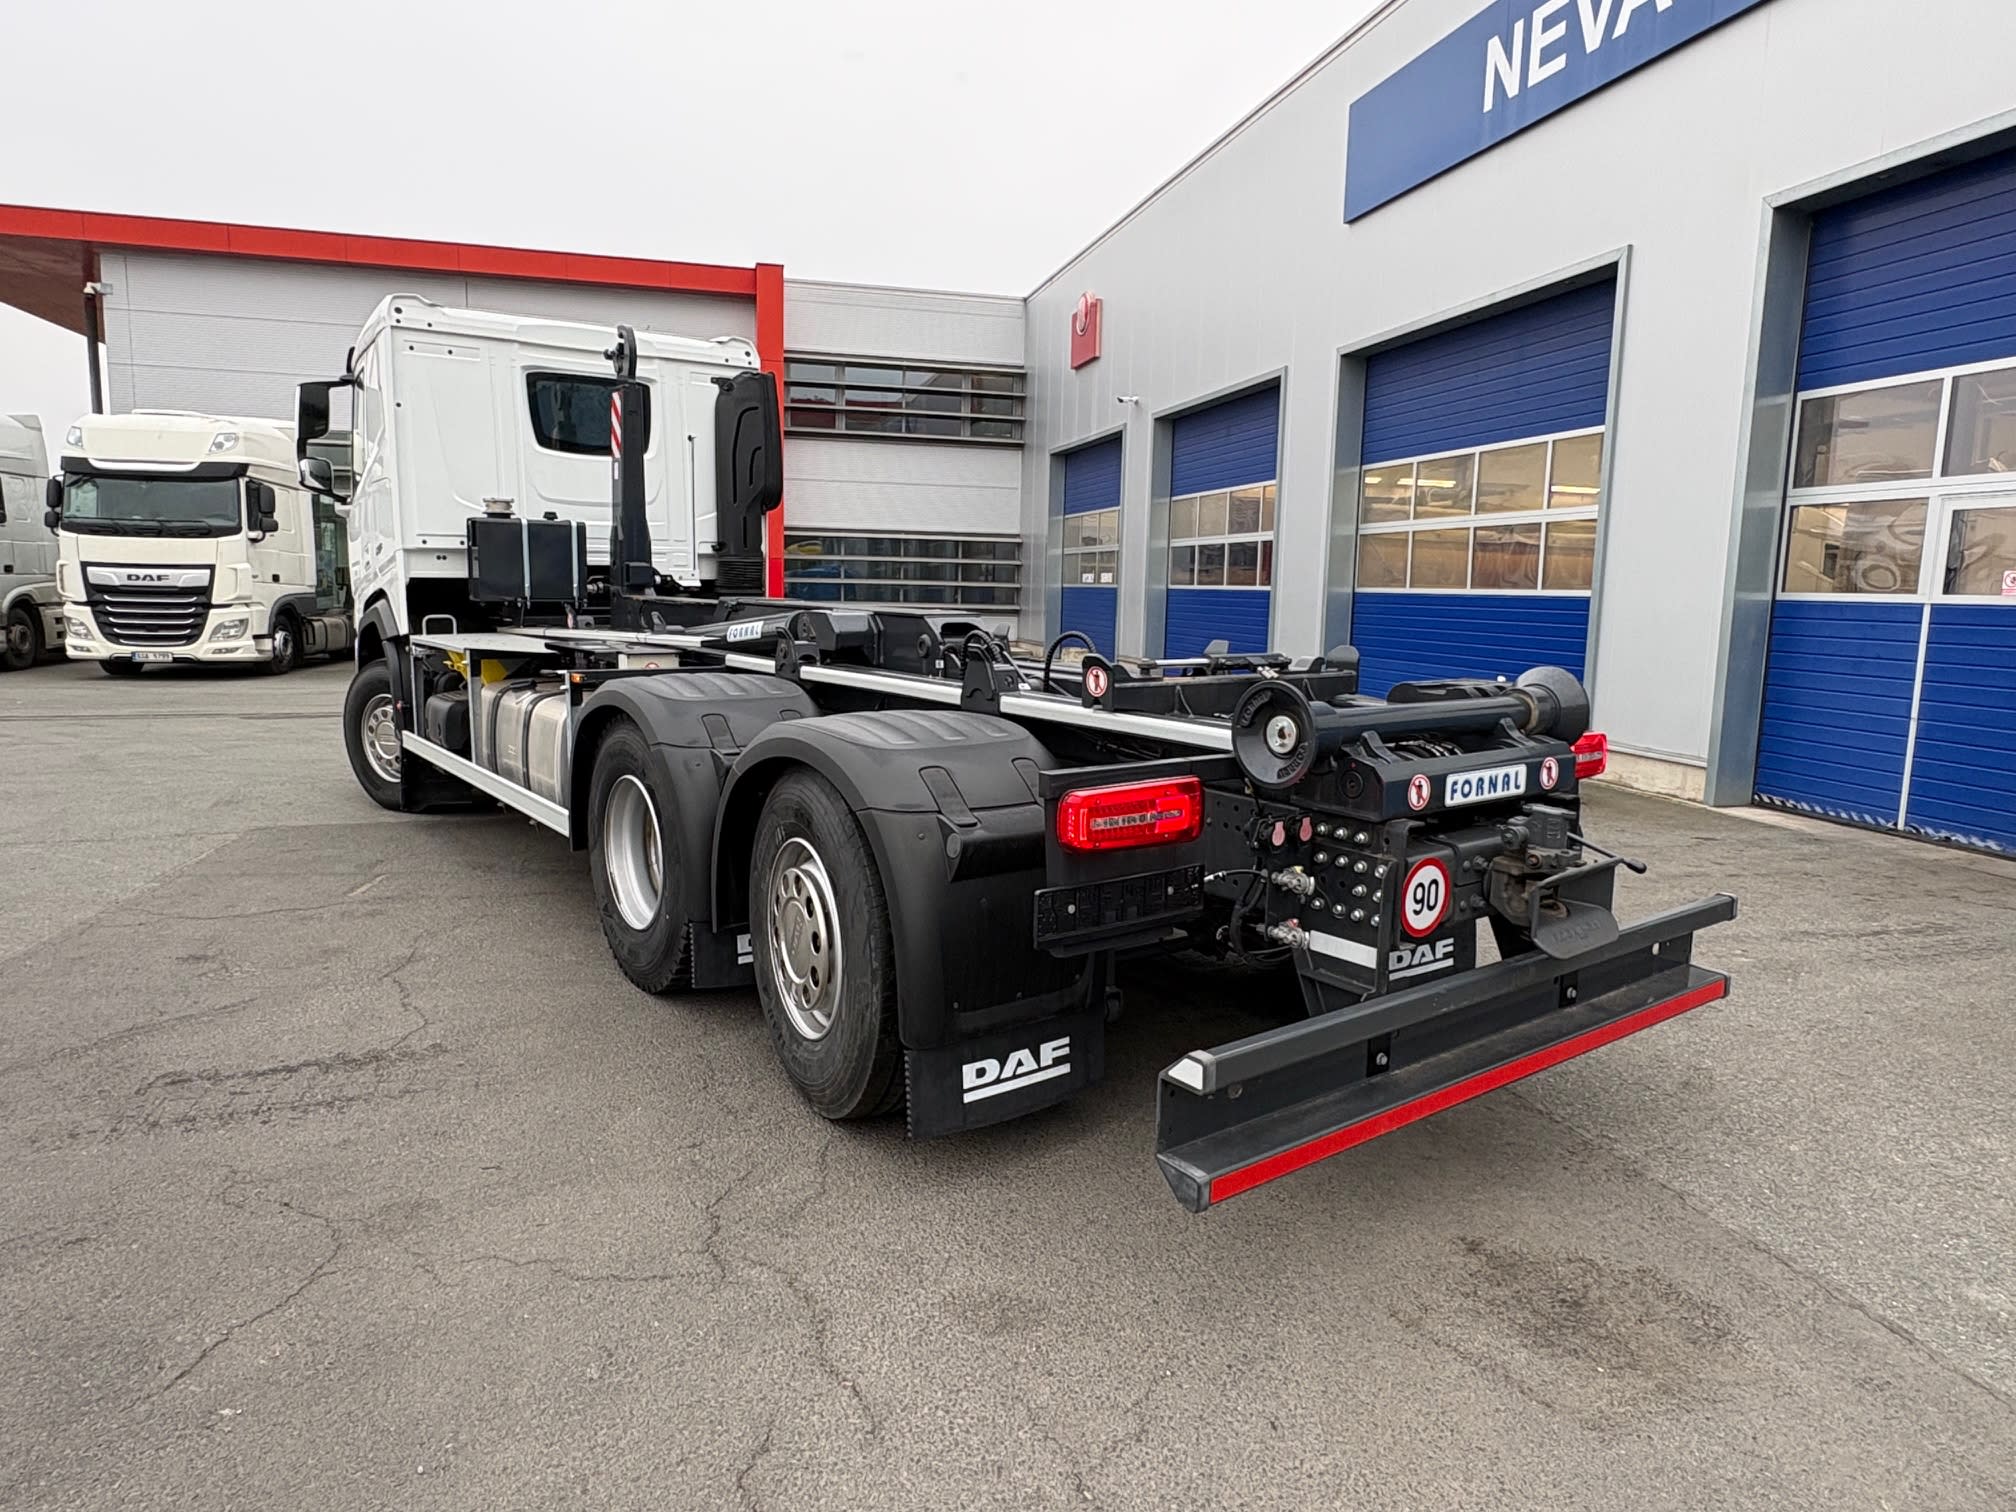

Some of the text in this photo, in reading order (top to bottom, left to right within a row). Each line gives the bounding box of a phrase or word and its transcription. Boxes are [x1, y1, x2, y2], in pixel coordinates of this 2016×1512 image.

[126, 574, 170, 582] DAF
[1450, 769, 1521, 801] FORNAL
[1412, 878, 1439, 917] 90
[1389, 937, 1454, 971] DAF
[962, 1035, 1071, 1090] DAF
